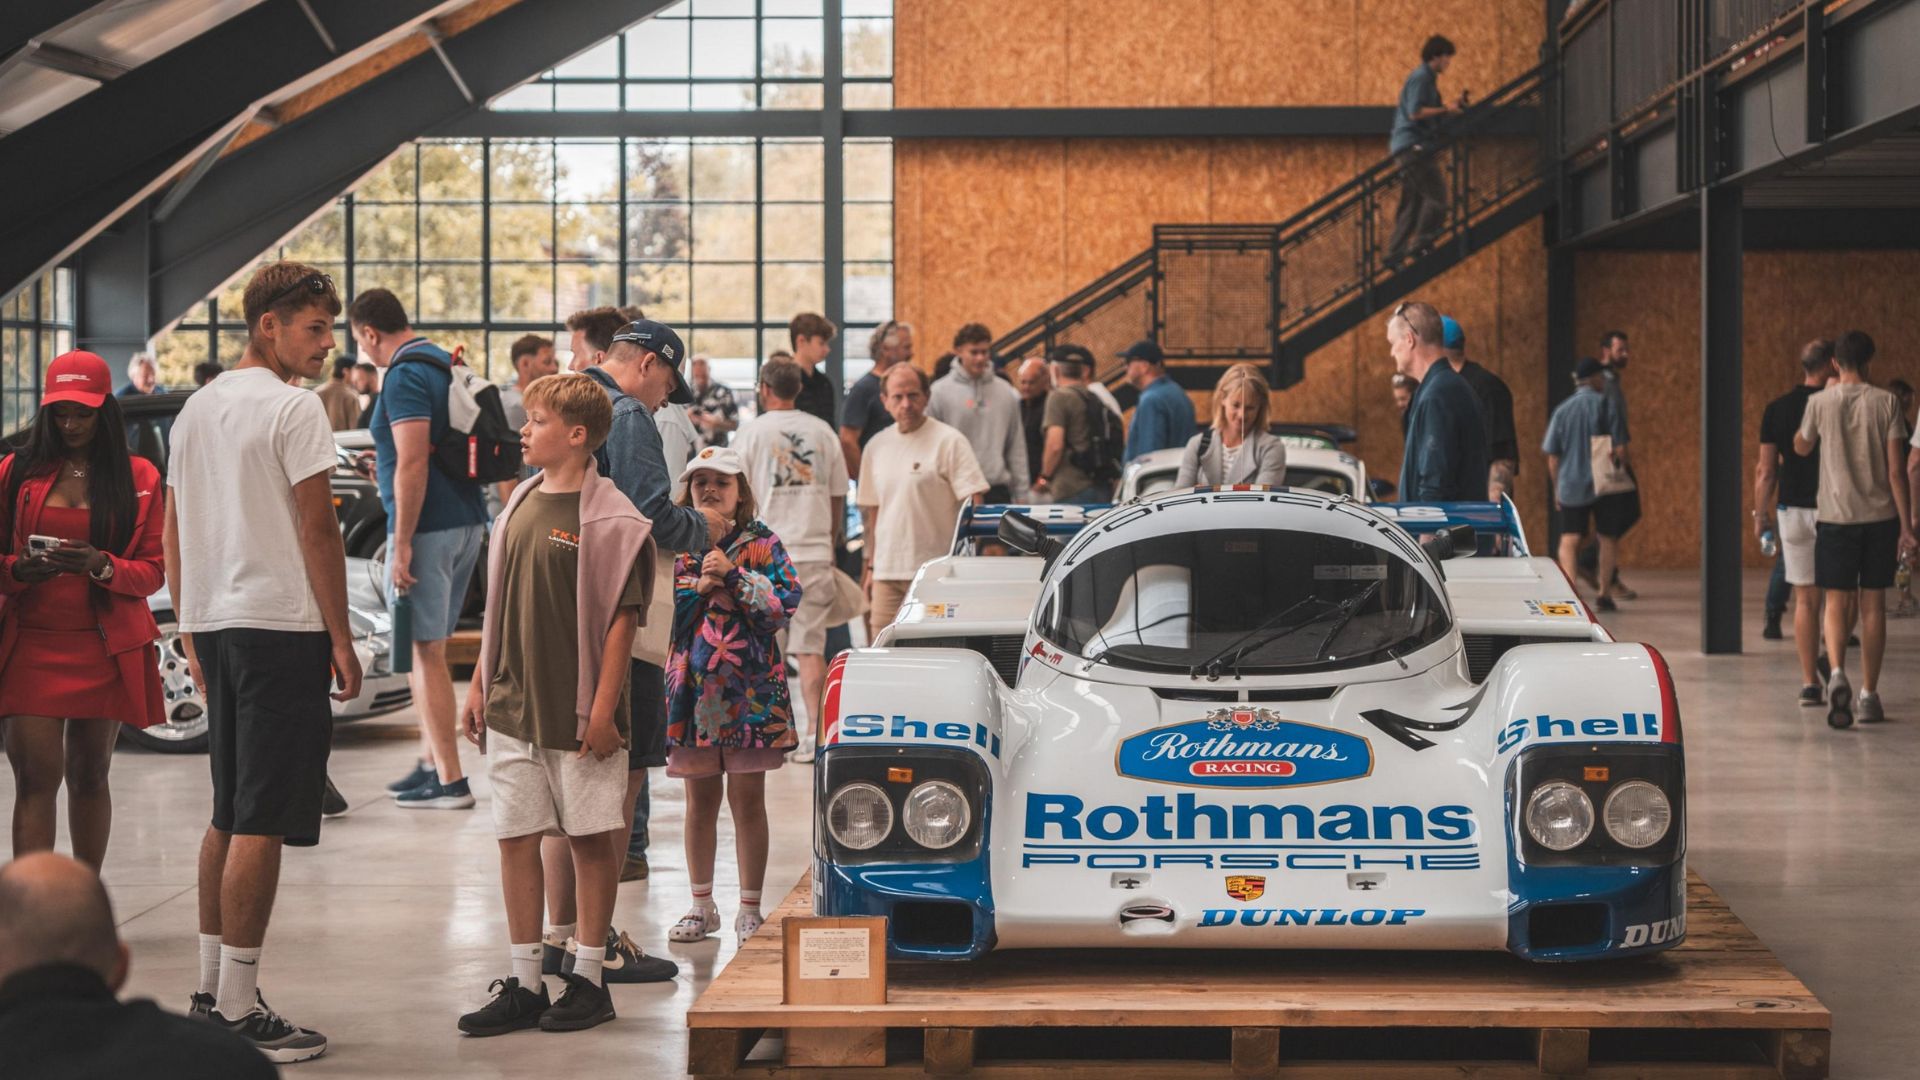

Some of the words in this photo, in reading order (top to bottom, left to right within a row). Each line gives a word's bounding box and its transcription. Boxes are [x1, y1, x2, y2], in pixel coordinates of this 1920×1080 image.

[1063, 493, 1424, 566] PORSCHE
[842, 714, 1000, 760] Shell
[1142, 732, 1348, 761] Rothmans
[1498, 713, 1658, 754] Shell
[1206, 763, 1281, 774] RACING
[1024, 792, 1477, 841] Rothmans
[1022, 853, 1480, 870] PORSCHE
[1196, 909, 1426, 927] DUNLOP
